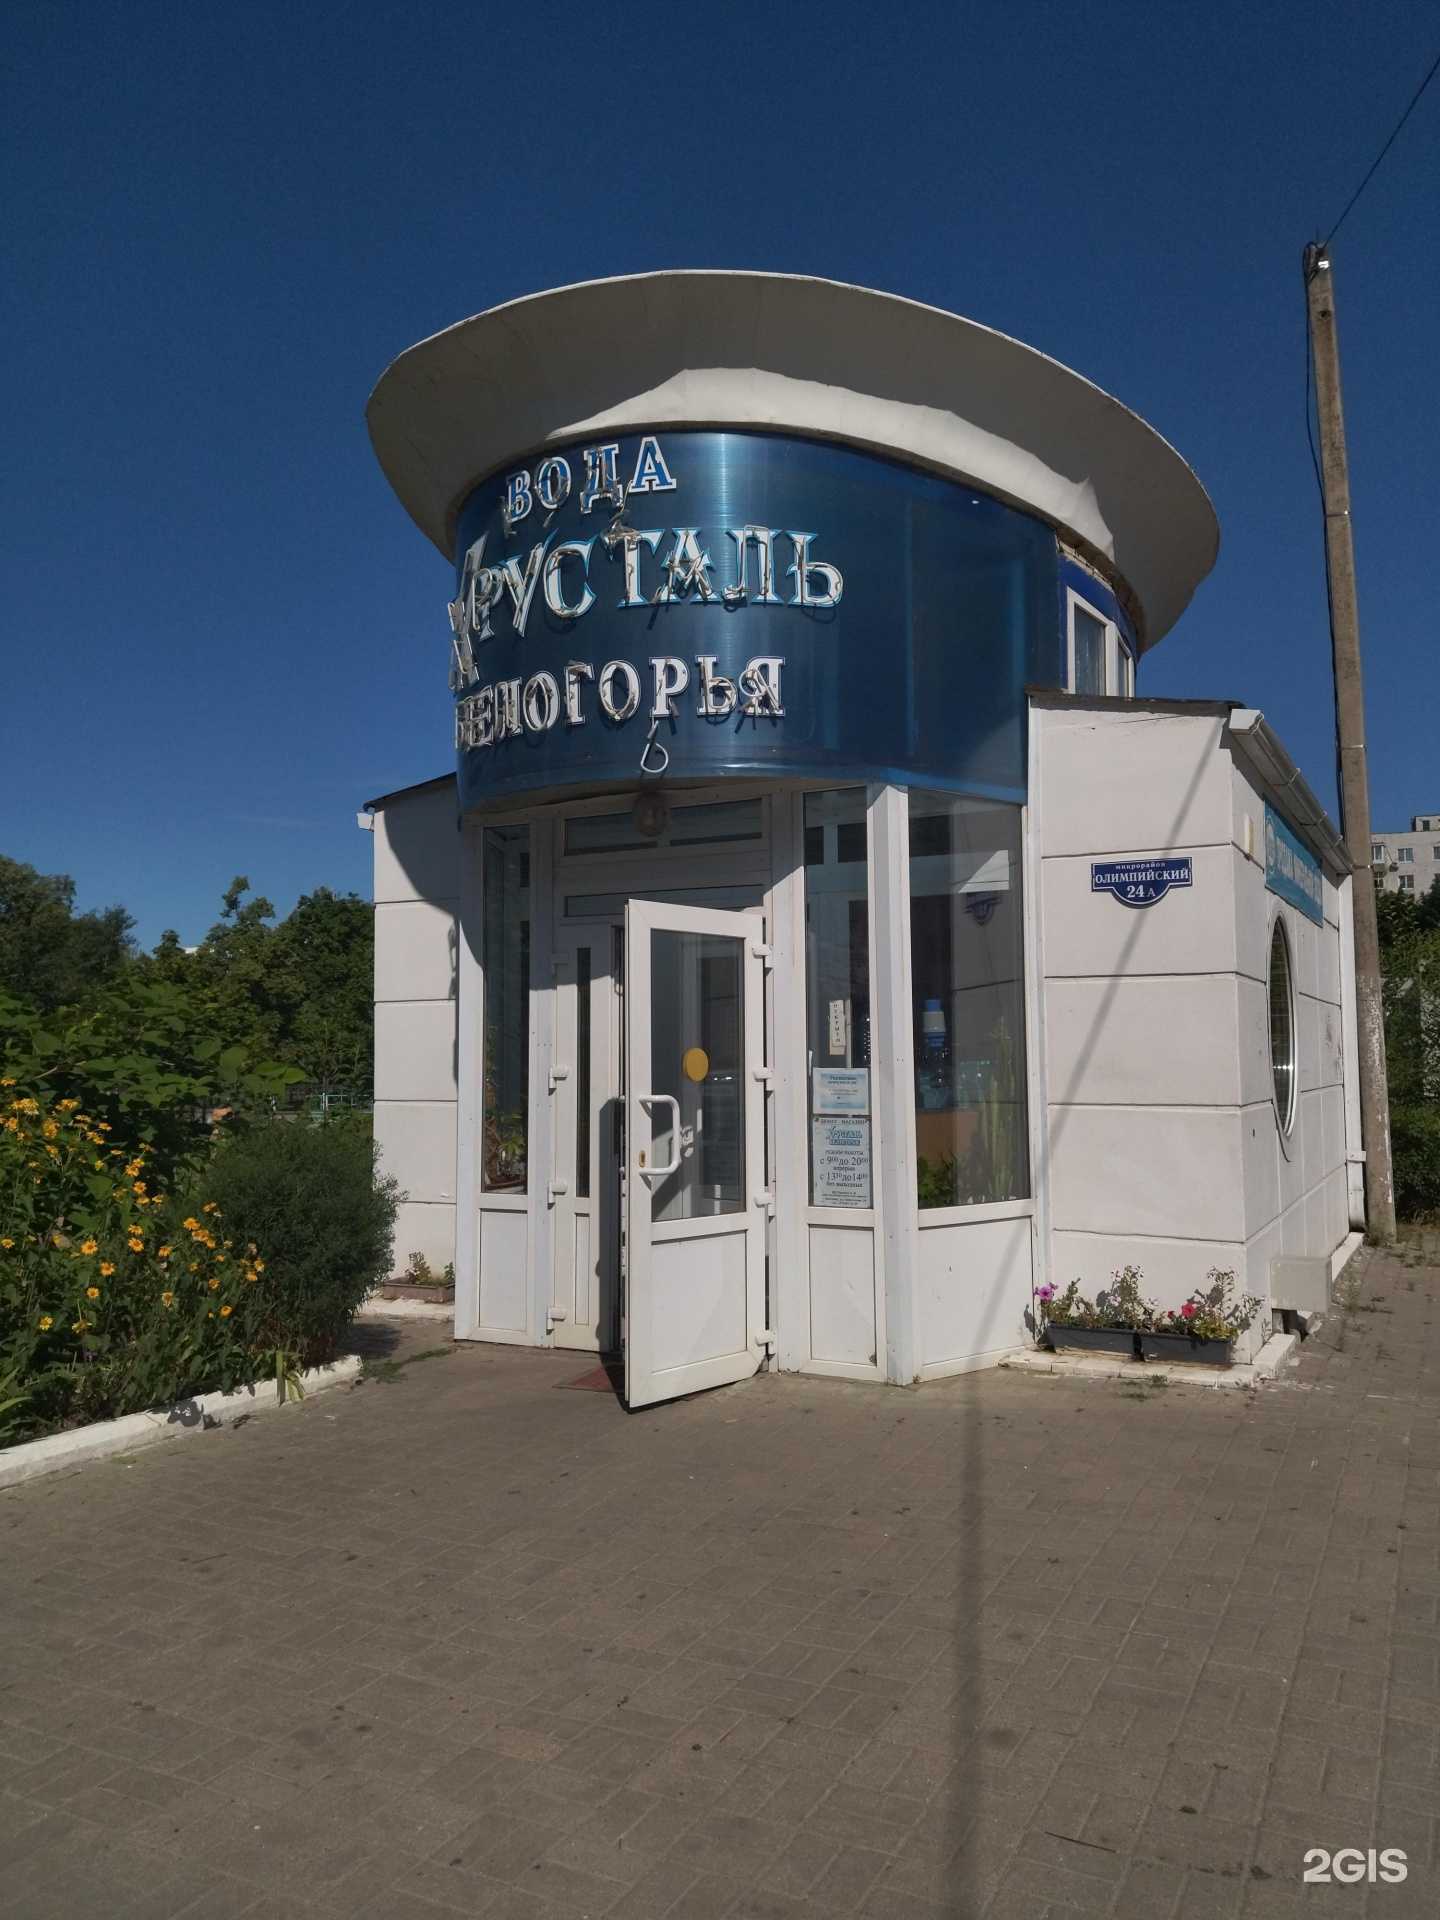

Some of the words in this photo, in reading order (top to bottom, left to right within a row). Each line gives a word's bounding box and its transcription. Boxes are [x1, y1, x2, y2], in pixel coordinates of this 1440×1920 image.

[504, 436, 677, 525] ВОДА
[1095, 868, 1189, 884] ОЛИМПИЙСКИЙ
[1127, 884, 1145, 898] 24
